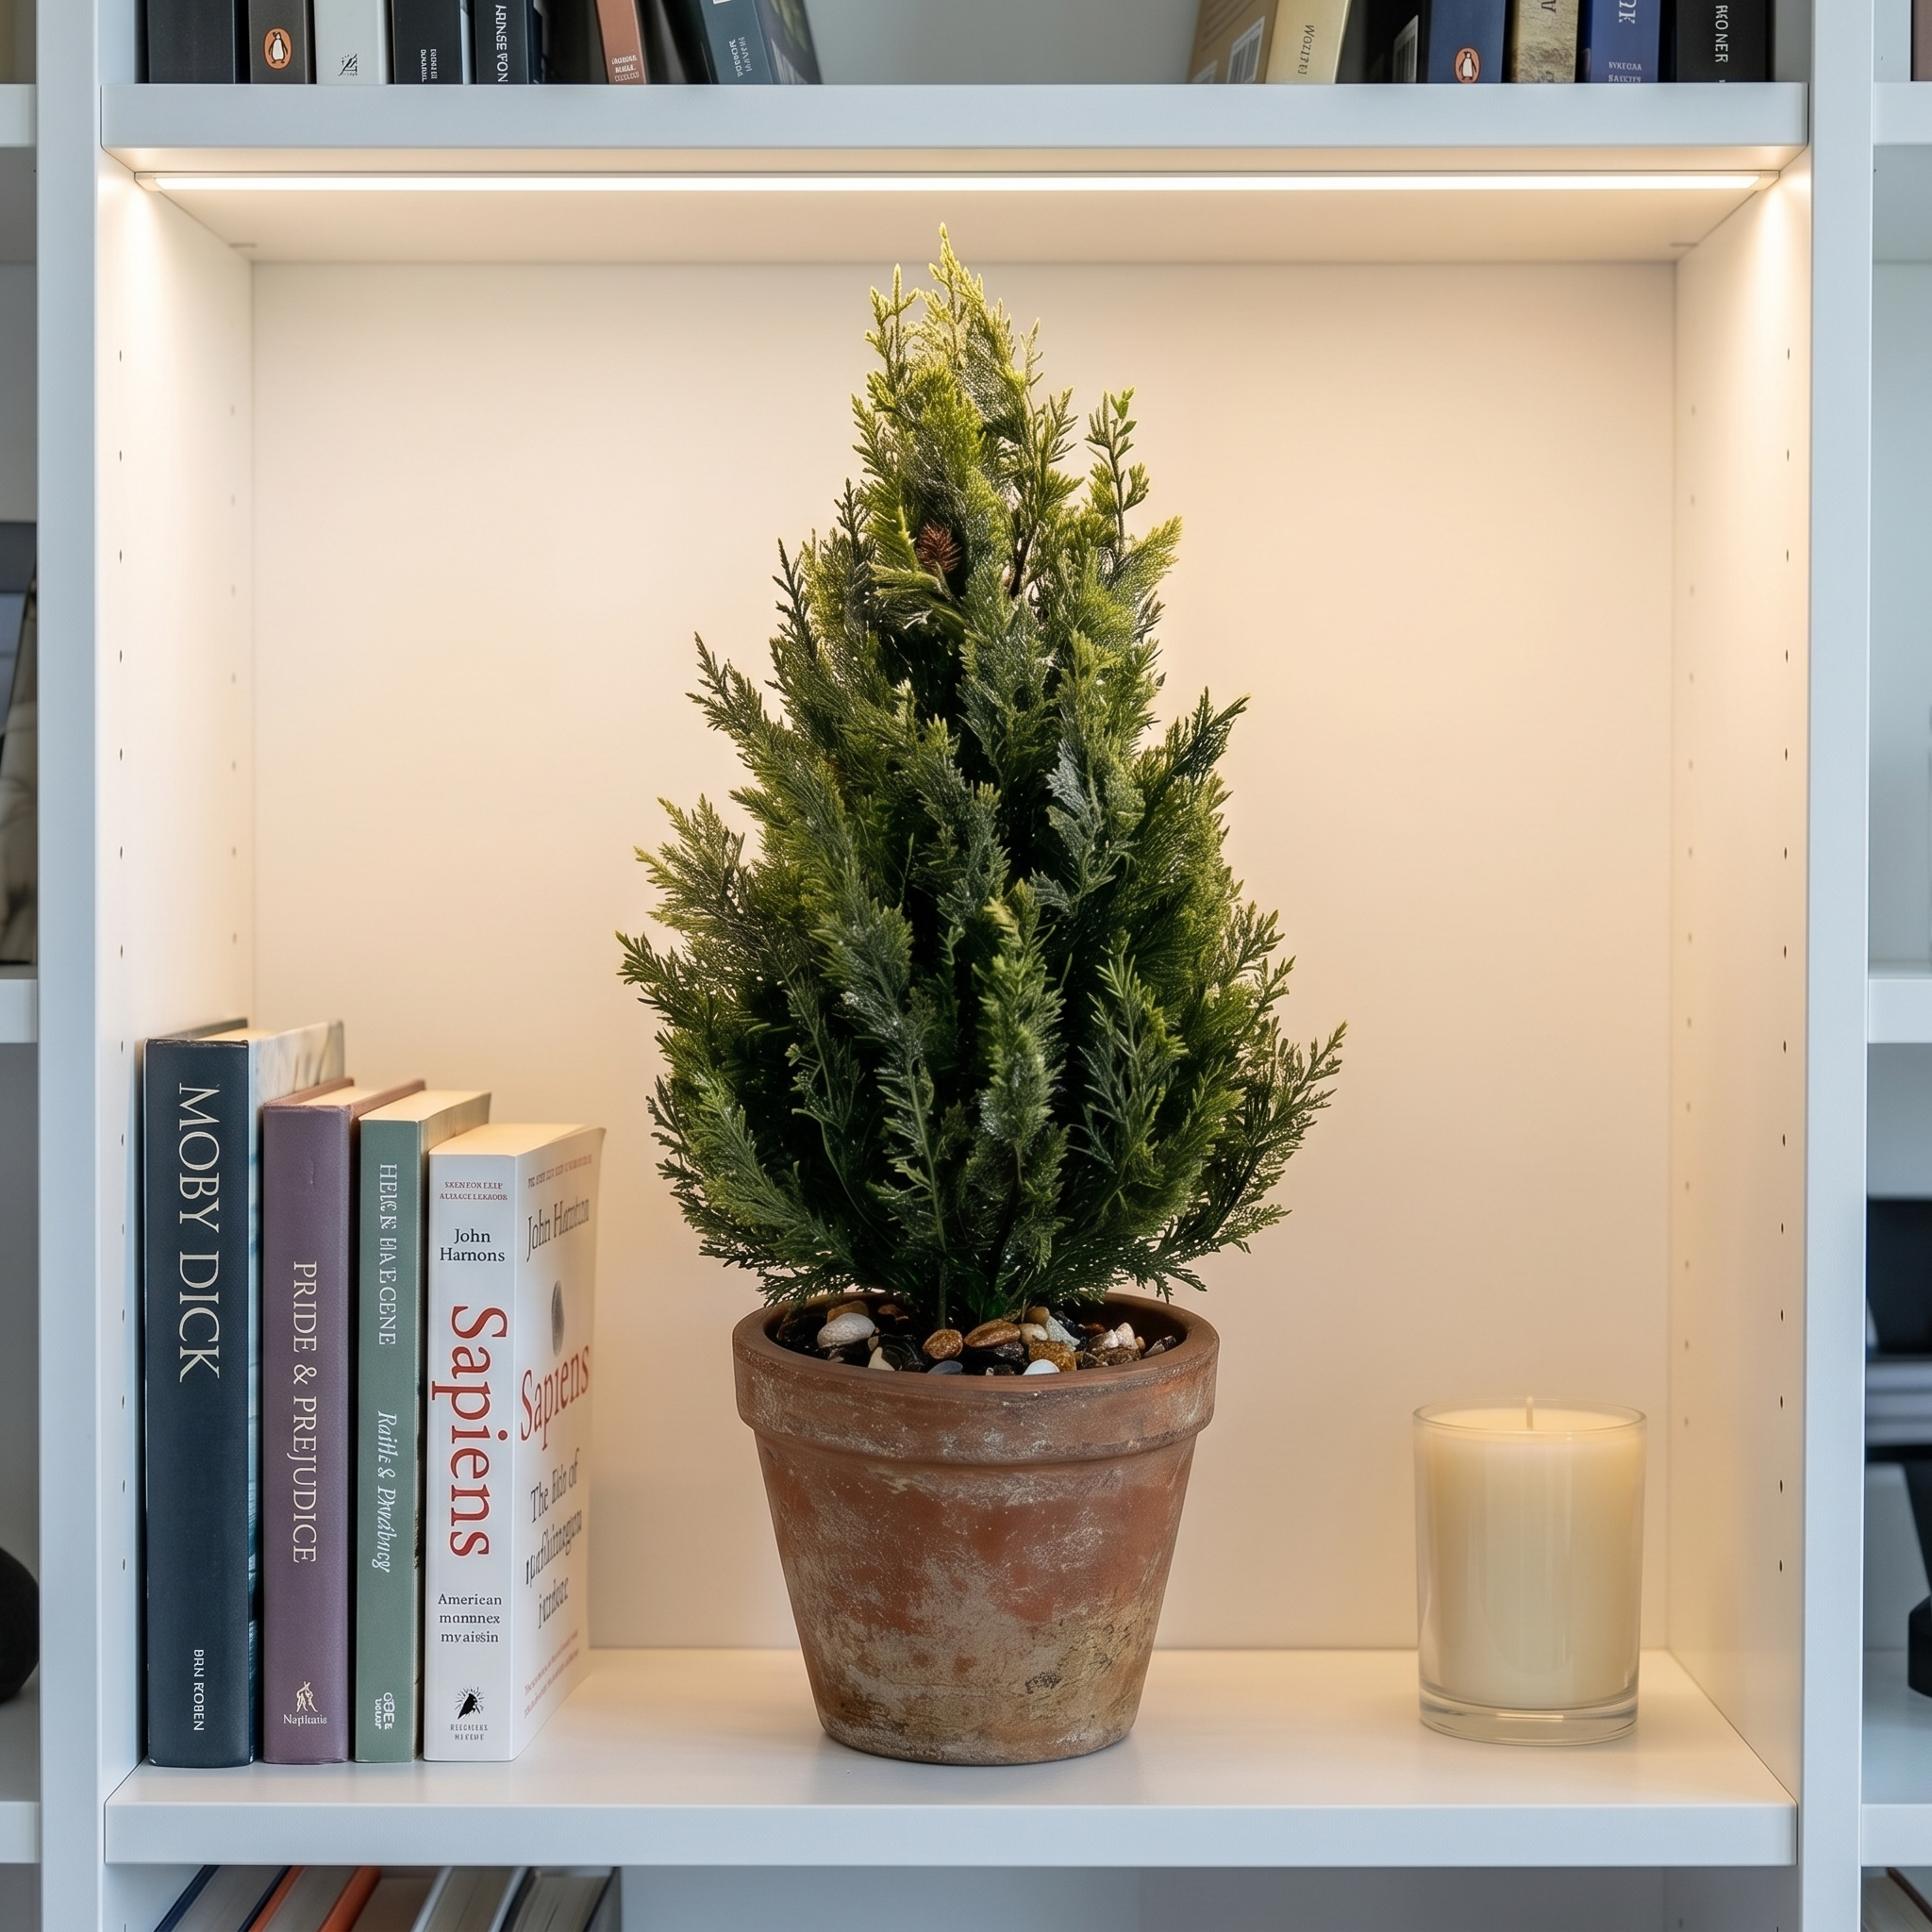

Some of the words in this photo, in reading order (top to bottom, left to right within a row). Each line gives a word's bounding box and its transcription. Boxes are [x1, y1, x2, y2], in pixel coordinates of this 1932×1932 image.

[178, 1083, 221, 1234] MOBY
[454, 1228, 491, 1244] John
[526, 1208, 551, 1263] John
[178, 1251, 221, 1383] DICK
[292, 1260, 317, 1354] PRIDE
[292, 1364, 317, 1386] &
[520, 1344, 590, 1452] Sapiens
[377, 1467, 396, 1479] &
[431, 1306, 508, 1558] Sapiens
[286, 1395, 317, 1564] PREJUDICE
[530, 1481, 549, 1524] The
